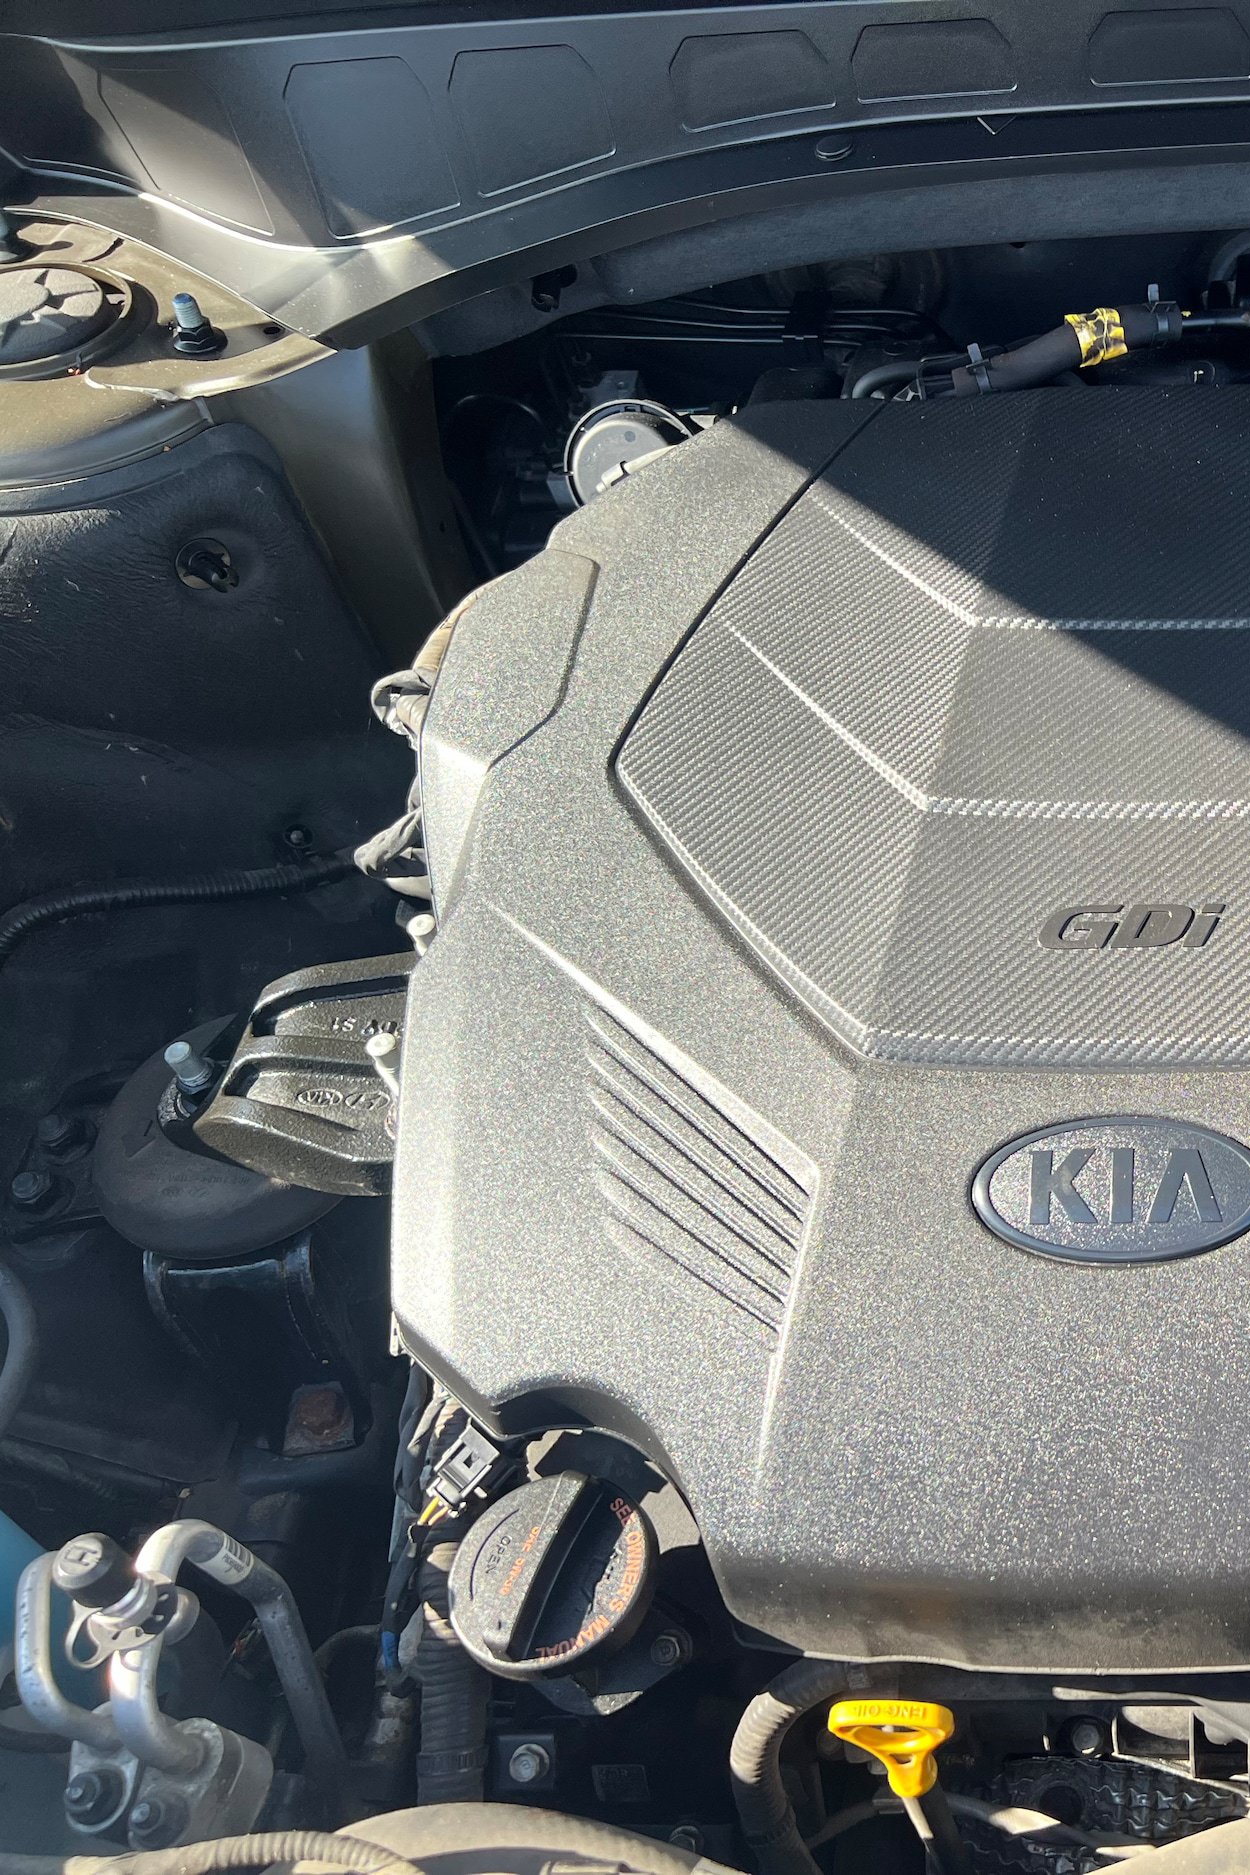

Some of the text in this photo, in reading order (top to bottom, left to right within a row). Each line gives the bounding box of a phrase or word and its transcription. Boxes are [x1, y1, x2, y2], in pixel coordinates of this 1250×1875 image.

[1039, 903, 1227, 949] GDi
[1028, 1148, 1223, 1225] KIA
[485, 1534, 513, 1575] OPEN
[609, 1530, 645, 1612] OWNER'S
[536, 1614, 612, 1664] MANUAL
